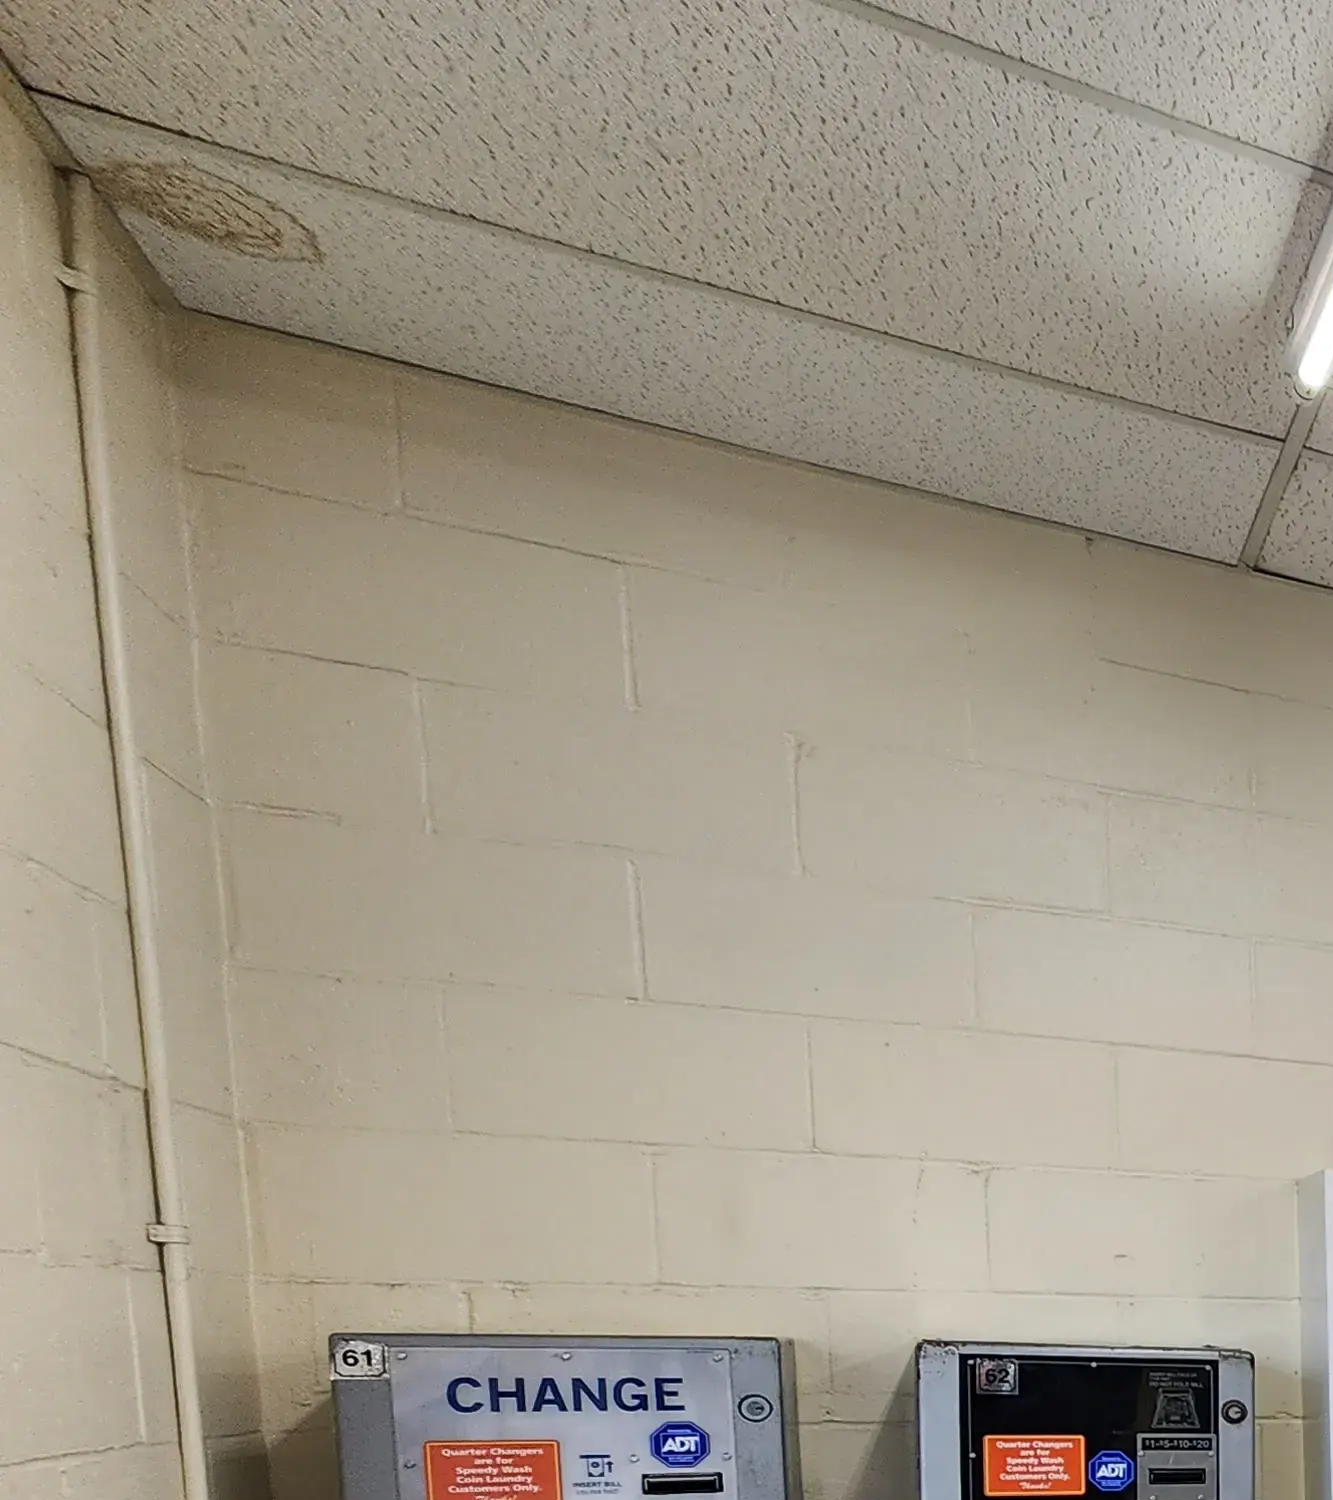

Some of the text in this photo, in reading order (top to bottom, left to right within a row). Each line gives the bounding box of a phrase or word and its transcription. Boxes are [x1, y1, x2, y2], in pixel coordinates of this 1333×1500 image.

[342, 1349, 374, 1368] 61
[985, 1369, 1010, 1384] 62
[446, 1377, 686, 1413] CHANGE
[661, 1436, 700, 1453] ADT
[996, 1440, 1073, 1449] Quarter Changers
[441, 1447, 544, 1457] Quarter Changers
[496, 1457, 514, 1465] for
[1006, 1456, 1064, 1465] Speedy Wash
[455, 1467, 498, 1475] Speedy
[1028, 1464, 1064, 1473] Laundry
[1096, 1463, 1127, 1478] ADT
[456, 1475, 533, 1484] Coin Laundry
[1000, 1472, 1071, 1481] Customers Only.
[448, 1484, 543, 1493] Customers Only.
